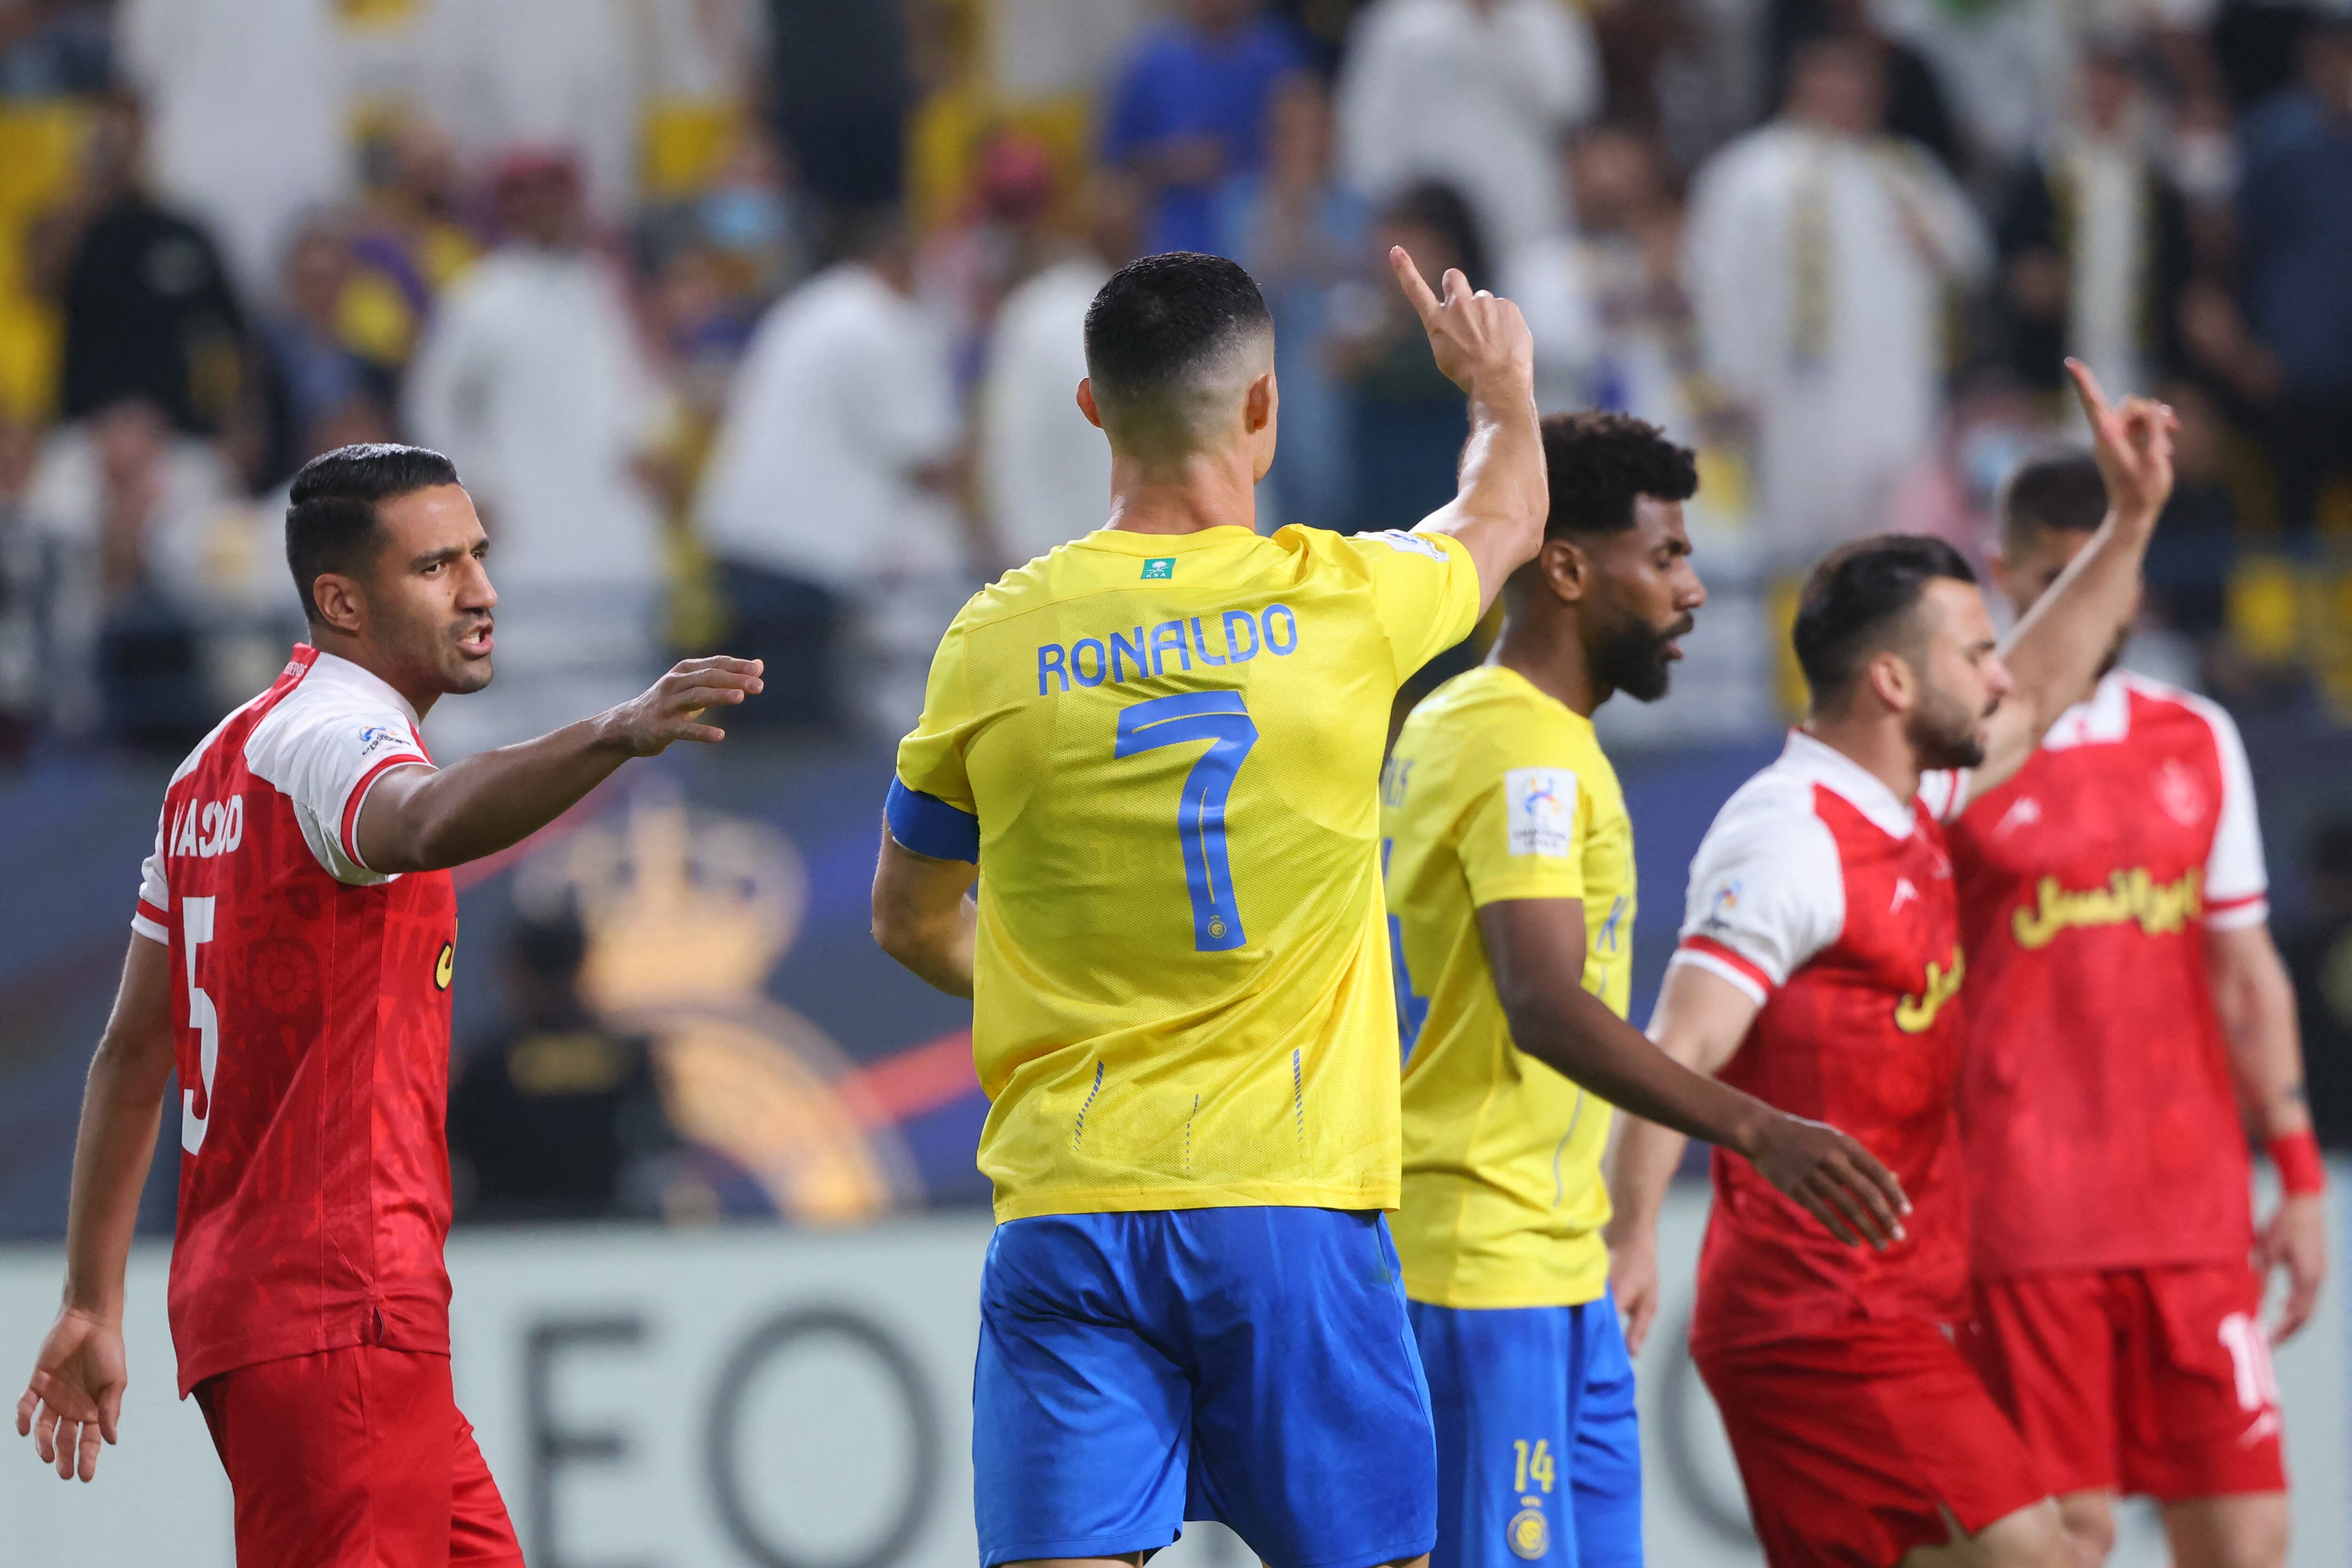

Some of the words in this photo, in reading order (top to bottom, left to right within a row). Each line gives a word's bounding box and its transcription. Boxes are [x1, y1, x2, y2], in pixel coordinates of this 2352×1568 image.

[1038, 604, 1297, 696] RONALDO
[1114, 691, 1259, 952] 7
[182, 895, 218, 1156] 5
[1514, 1439, 1555, 1493] 14
